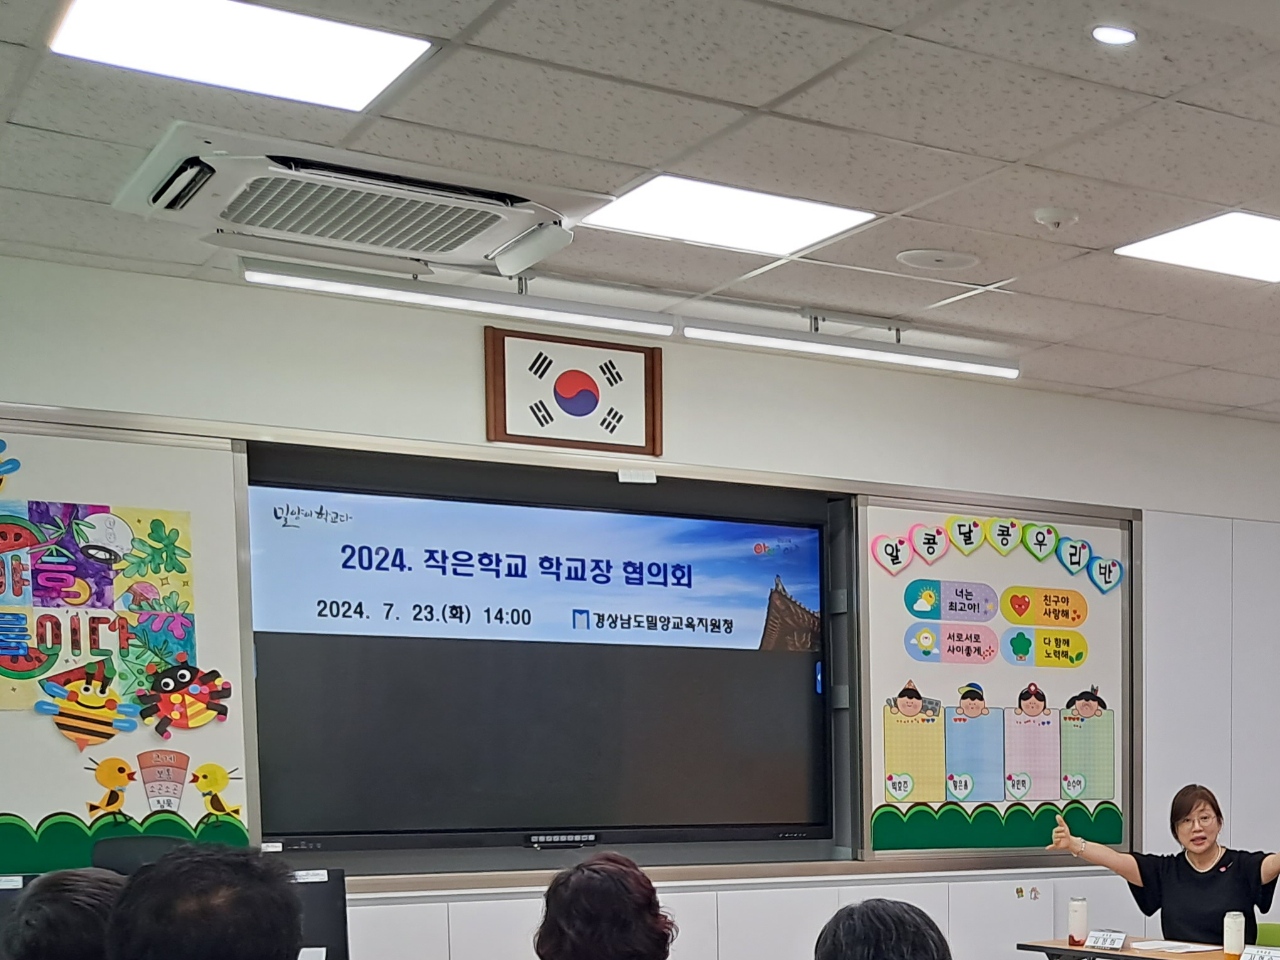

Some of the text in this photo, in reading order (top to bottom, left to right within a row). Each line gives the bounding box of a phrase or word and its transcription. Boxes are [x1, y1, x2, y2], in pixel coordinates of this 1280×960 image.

[314, 504, 354, 524] 학교다
[340, 543, 693, 589] 2024. 작은학교 학교장 협의회
[955, 588, 974, 601] 너는
[1042, 594, 1070, 607] 친구야
[316, 599, 532, 626] 2024. 7. 23.(화) 14:00
[948, 601, 980, 614] 최고야!
[1042, 609, 1070, 621] 사랑해
[592, 612, 734, 634] 경상남도밀양교육지원청
[946, 632, 982, 644] 서로서로
[1043, 637, 1070, 649] 다 함께
[946, 645, 982, 657] 사이좋게
[1044, 649, 1070, 660] 노력해
[149, 783, 178, 795] 소곤소곤
